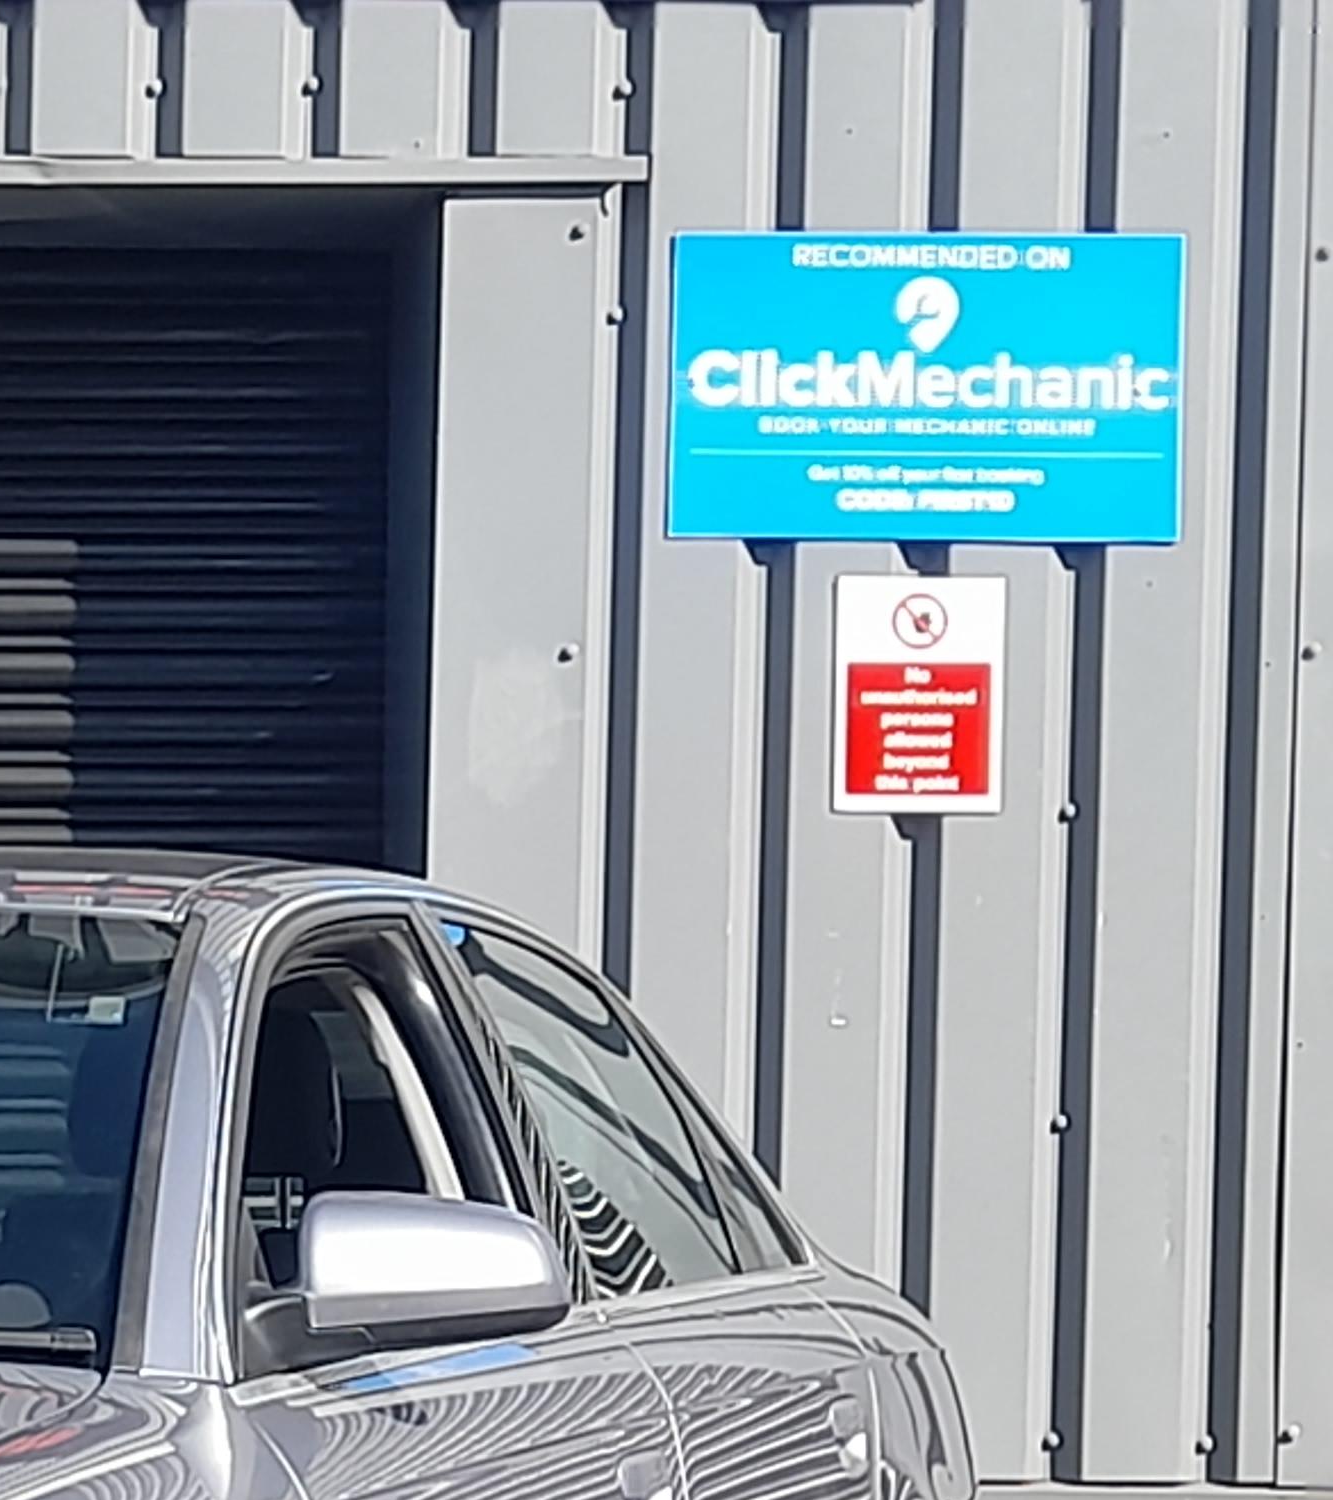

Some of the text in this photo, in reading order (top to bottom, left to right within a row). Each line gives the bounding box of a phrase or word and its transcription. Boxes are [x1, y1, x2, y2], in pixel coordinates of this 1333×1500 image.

[792, 243, 1072, 270] RECOMMENDED ON
[687, 348, 1172, 409] ClickMechanic
[893, 418, 1011, 435] MECHANIC
[1015, 418, 1096, 436] ONLINE
